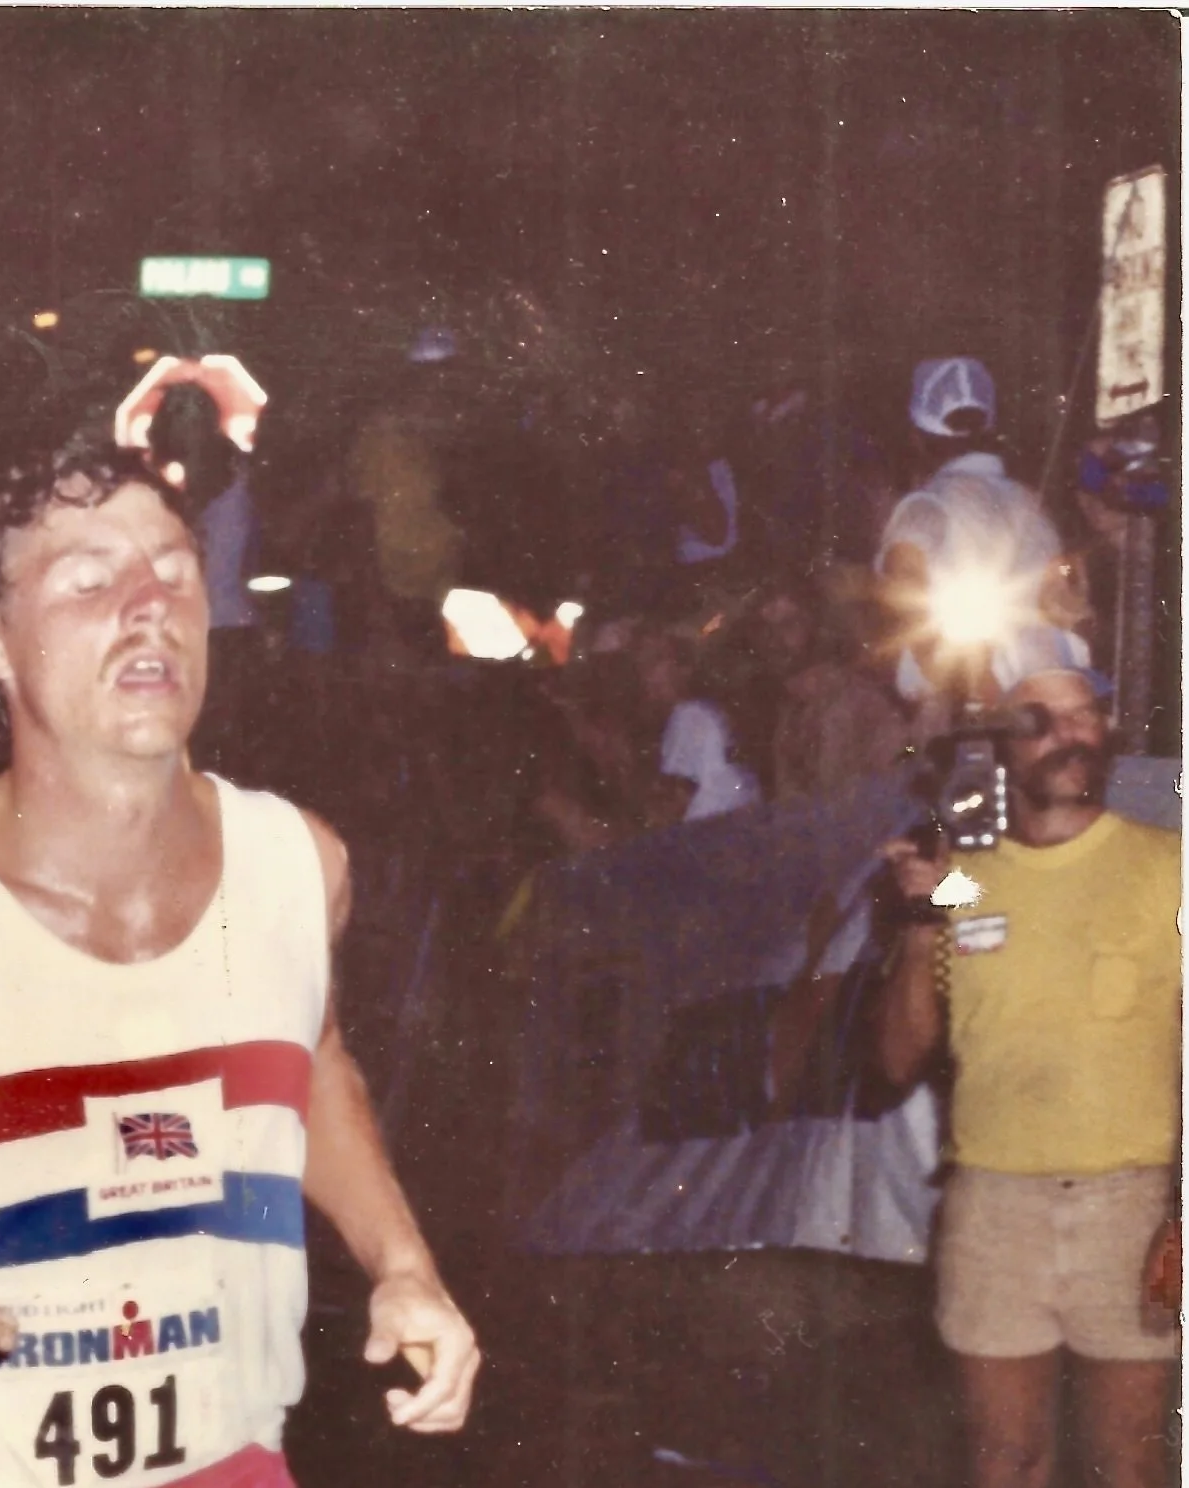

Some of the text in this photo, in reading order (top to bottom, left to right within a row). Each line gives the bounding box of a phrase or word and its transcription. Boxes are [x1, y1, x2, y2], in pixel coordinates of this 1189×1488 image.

[98, 1176, 212, 1200] GREAT BRITAIN
[33, 1374, 186, 1486] 491
